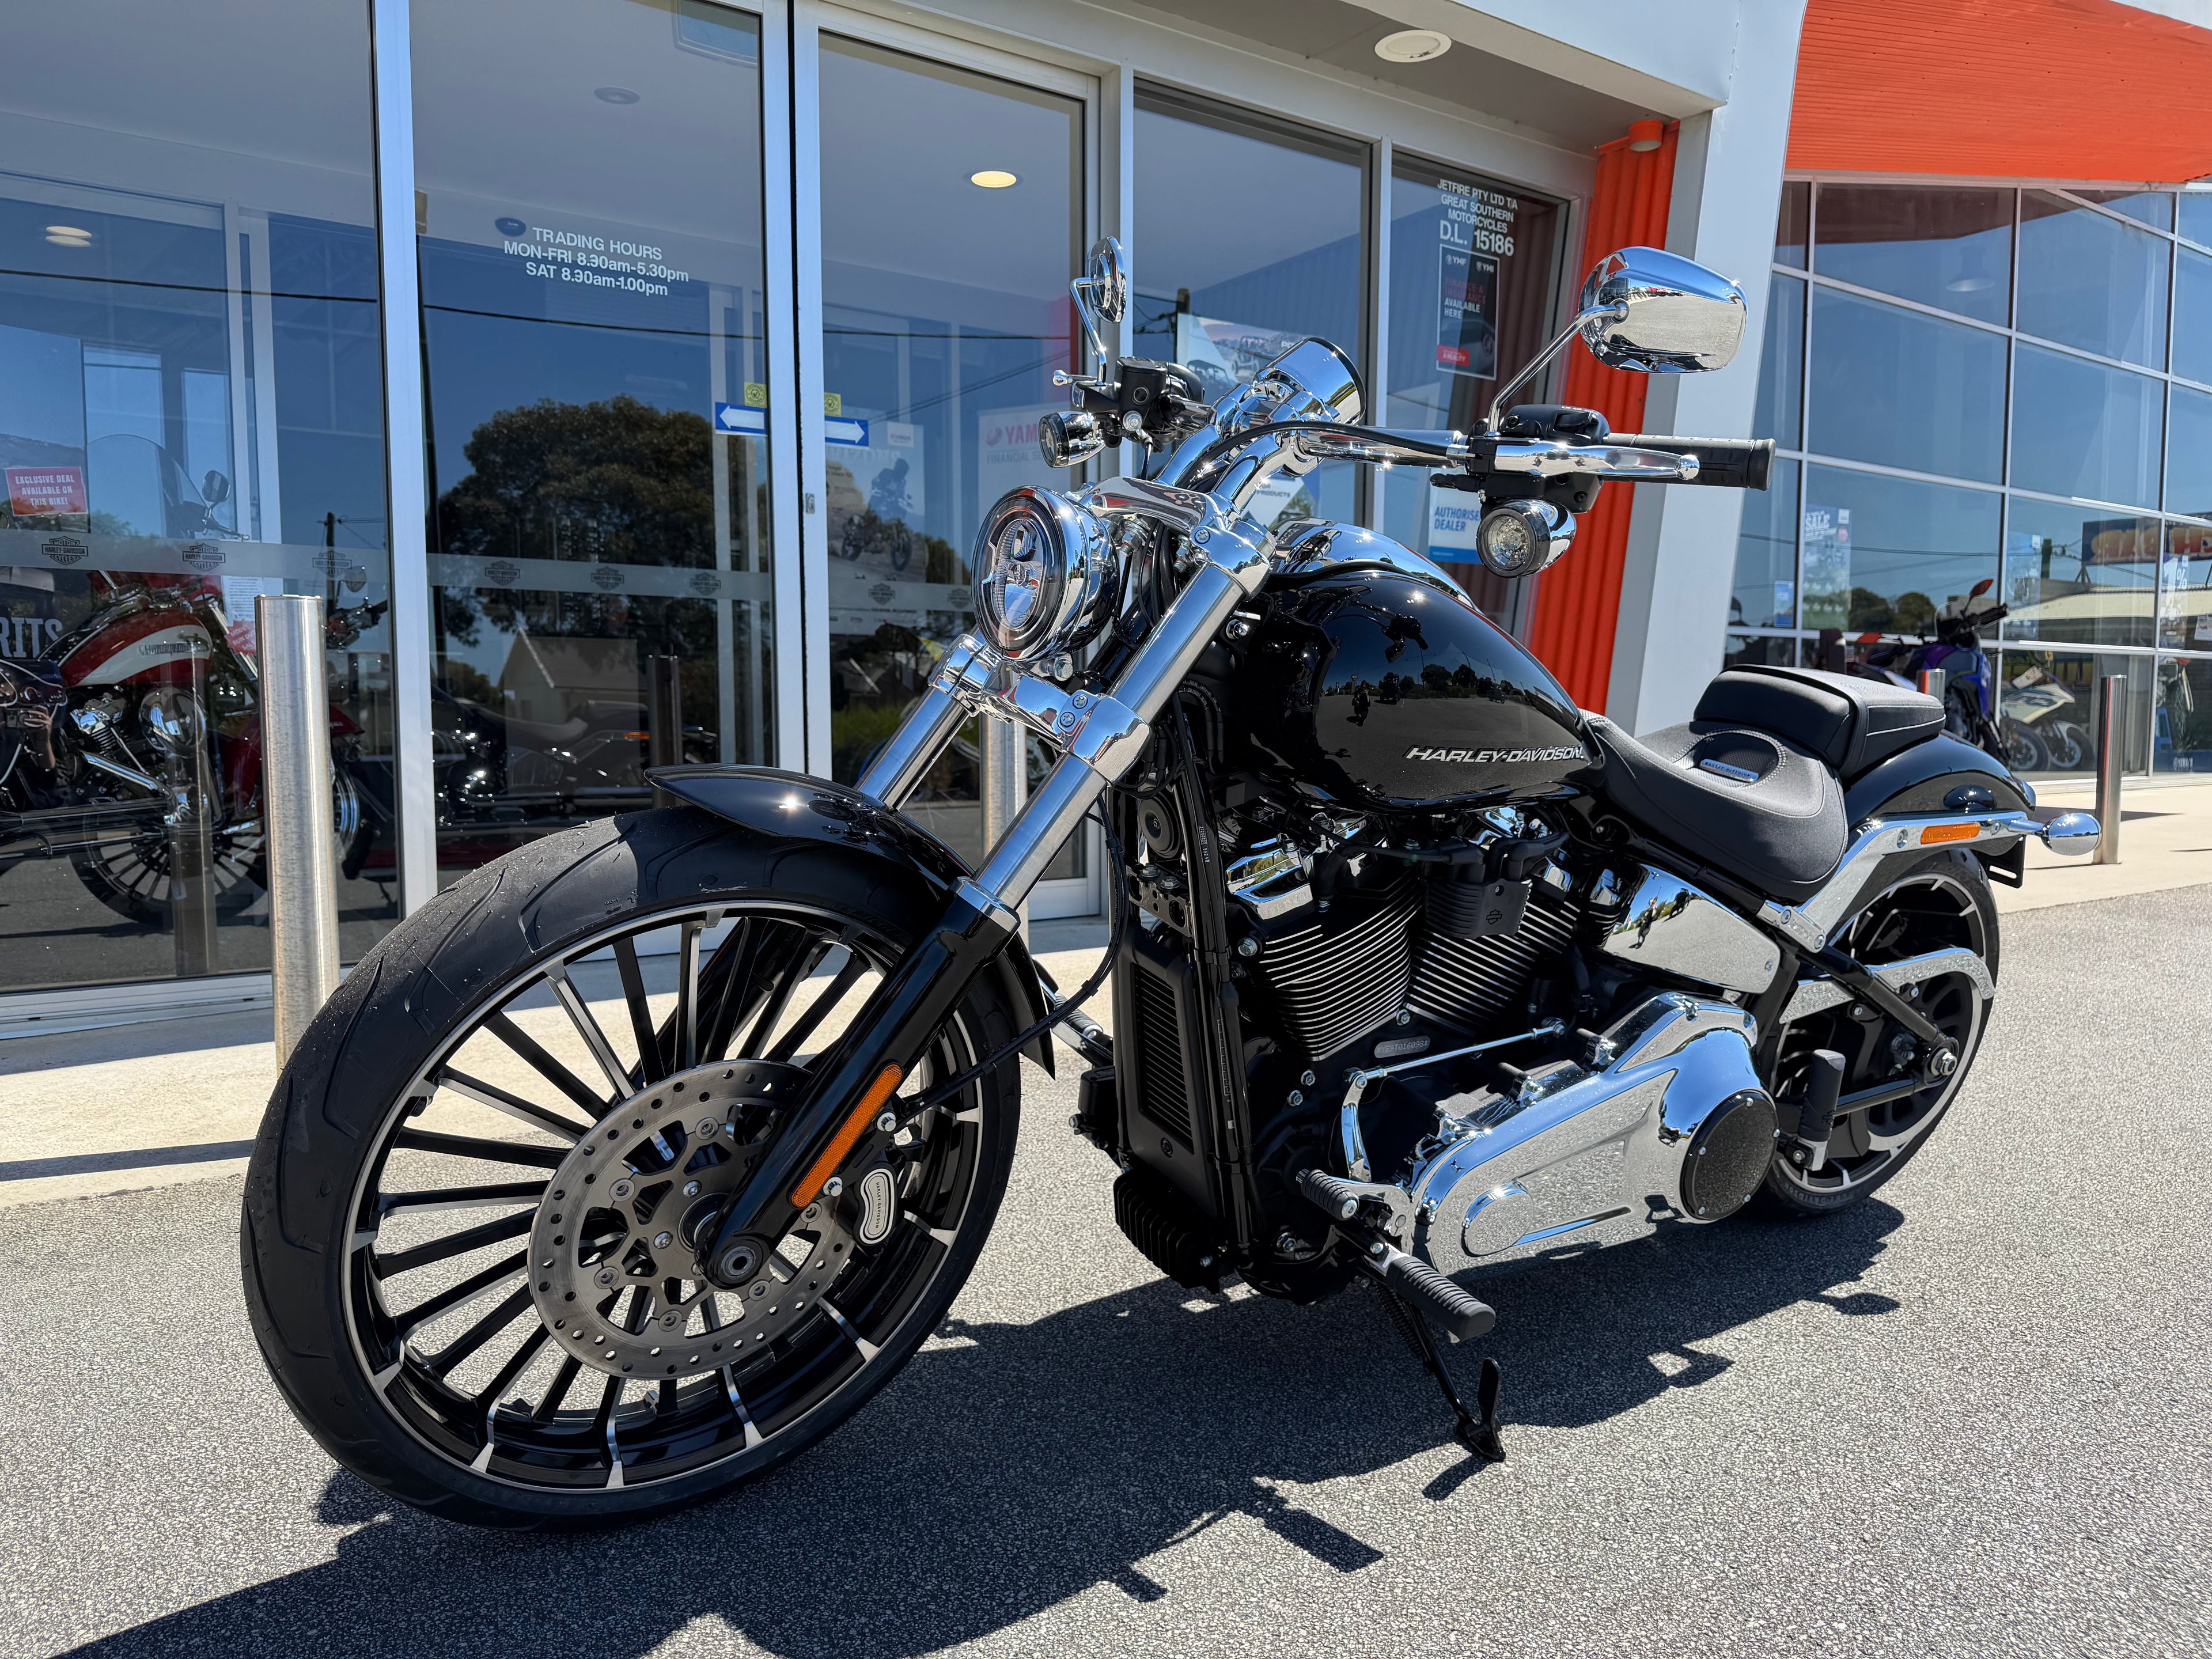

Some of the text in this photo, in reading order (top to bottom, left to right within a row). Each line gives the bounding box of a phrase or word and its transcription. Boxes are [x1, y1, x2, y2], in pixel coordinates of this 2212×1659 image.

[1437, 179, 1518, 210] JETFIRE PTY LTD T/A
[1441, 194, 1514, 222] GREAT SOUTHERN
[1448, 209, 1508, 233] MOTORCYCLES
[533, 227, 662, 260] TRADING HOURS
[1440, 220, 1514, 256] D.L. 15186
[504, 240, 572, 264] MON-FRI
[525, 262, 556, 279] SAT
[1444, 297, 1480, 313] AVAILABLE
[1444, 308, 1462, 319] HERE
[1006, 424, 1038, 445] YAM
[15, 475, 75, 484] EXCLUSIVE DEAL
[21, 486, 73, 495] AVAILABLE ON
[1434, 507, 1480, 521] AUTHORISE
[1434, 519, 1466, 532] DEALER
[1406, 747, 1583, 762] HARLEY-DAVIDSON
